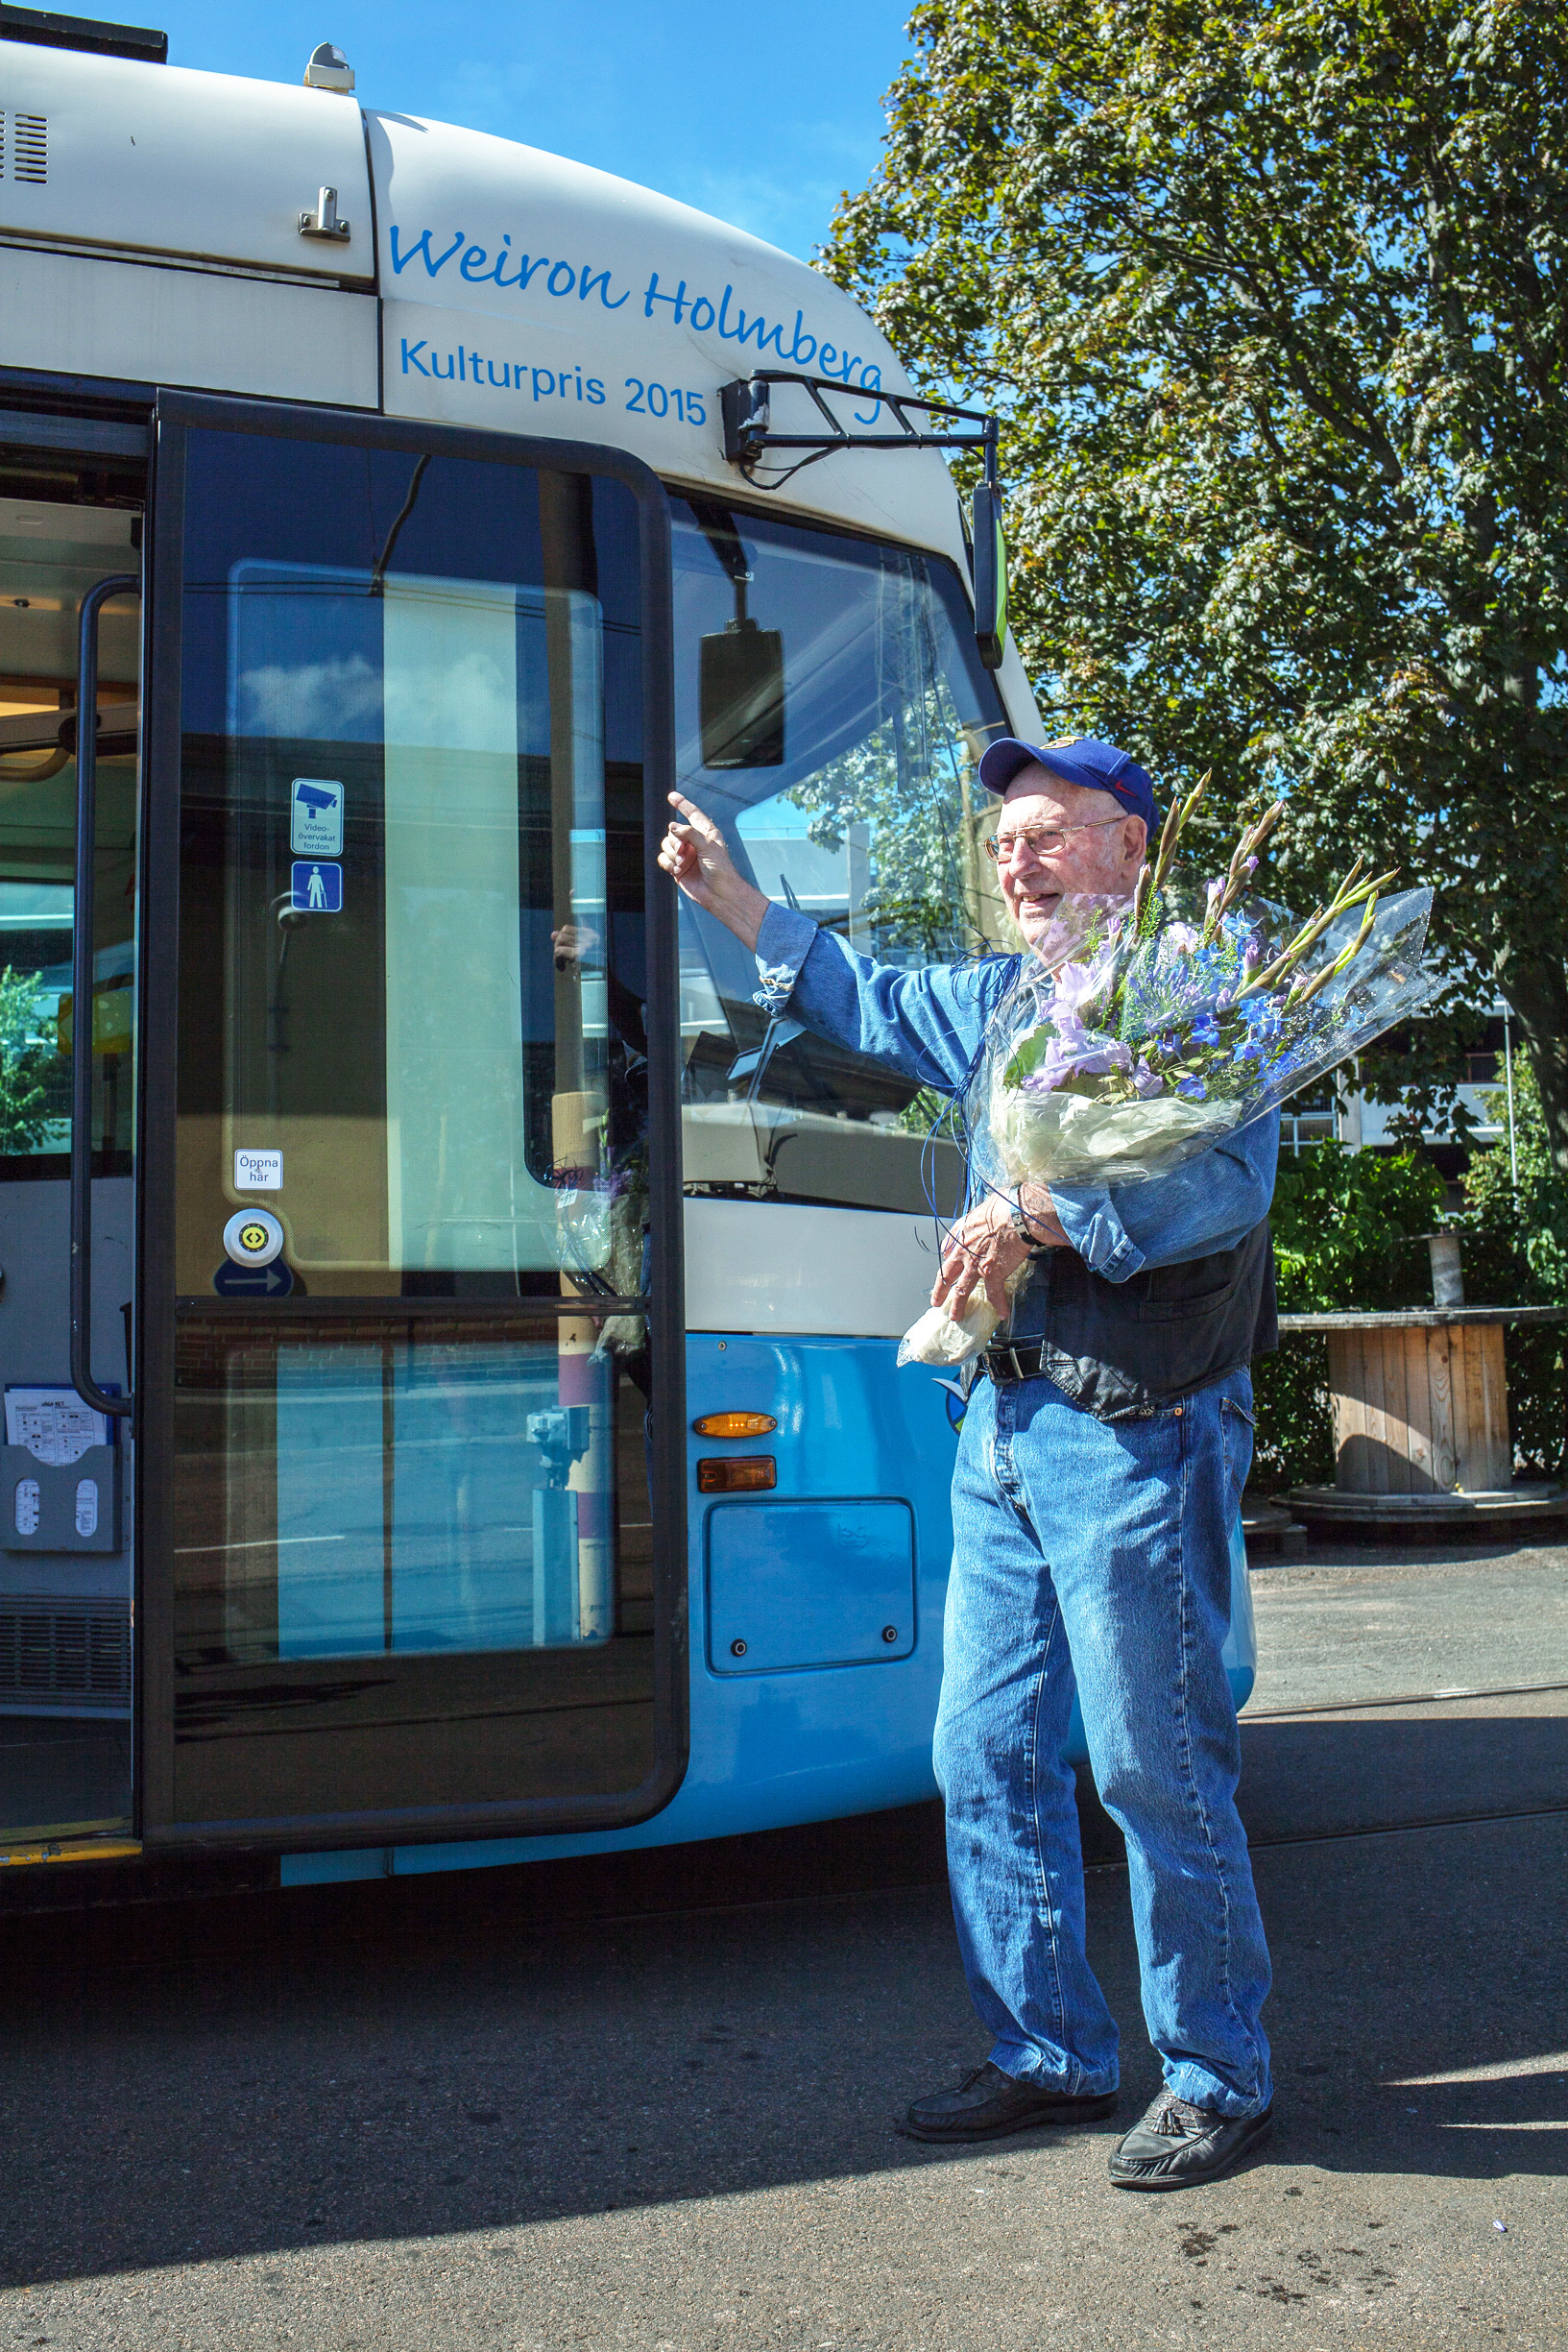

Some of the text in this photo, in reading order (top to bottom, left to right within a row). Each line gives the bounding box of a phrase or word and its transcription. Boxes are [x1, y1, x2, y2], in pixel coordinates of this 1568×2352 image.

[389, 225, 881, 424] Weiron Holmberg
[400, 337, 707, 426] Kulturpris 2015
[304, 823, 329, 832] Video-
[298, 833, 336, 841] övervakat
[240, 1154, 278, 1169] Öppna
[250, 1172, 269, 1181] här
